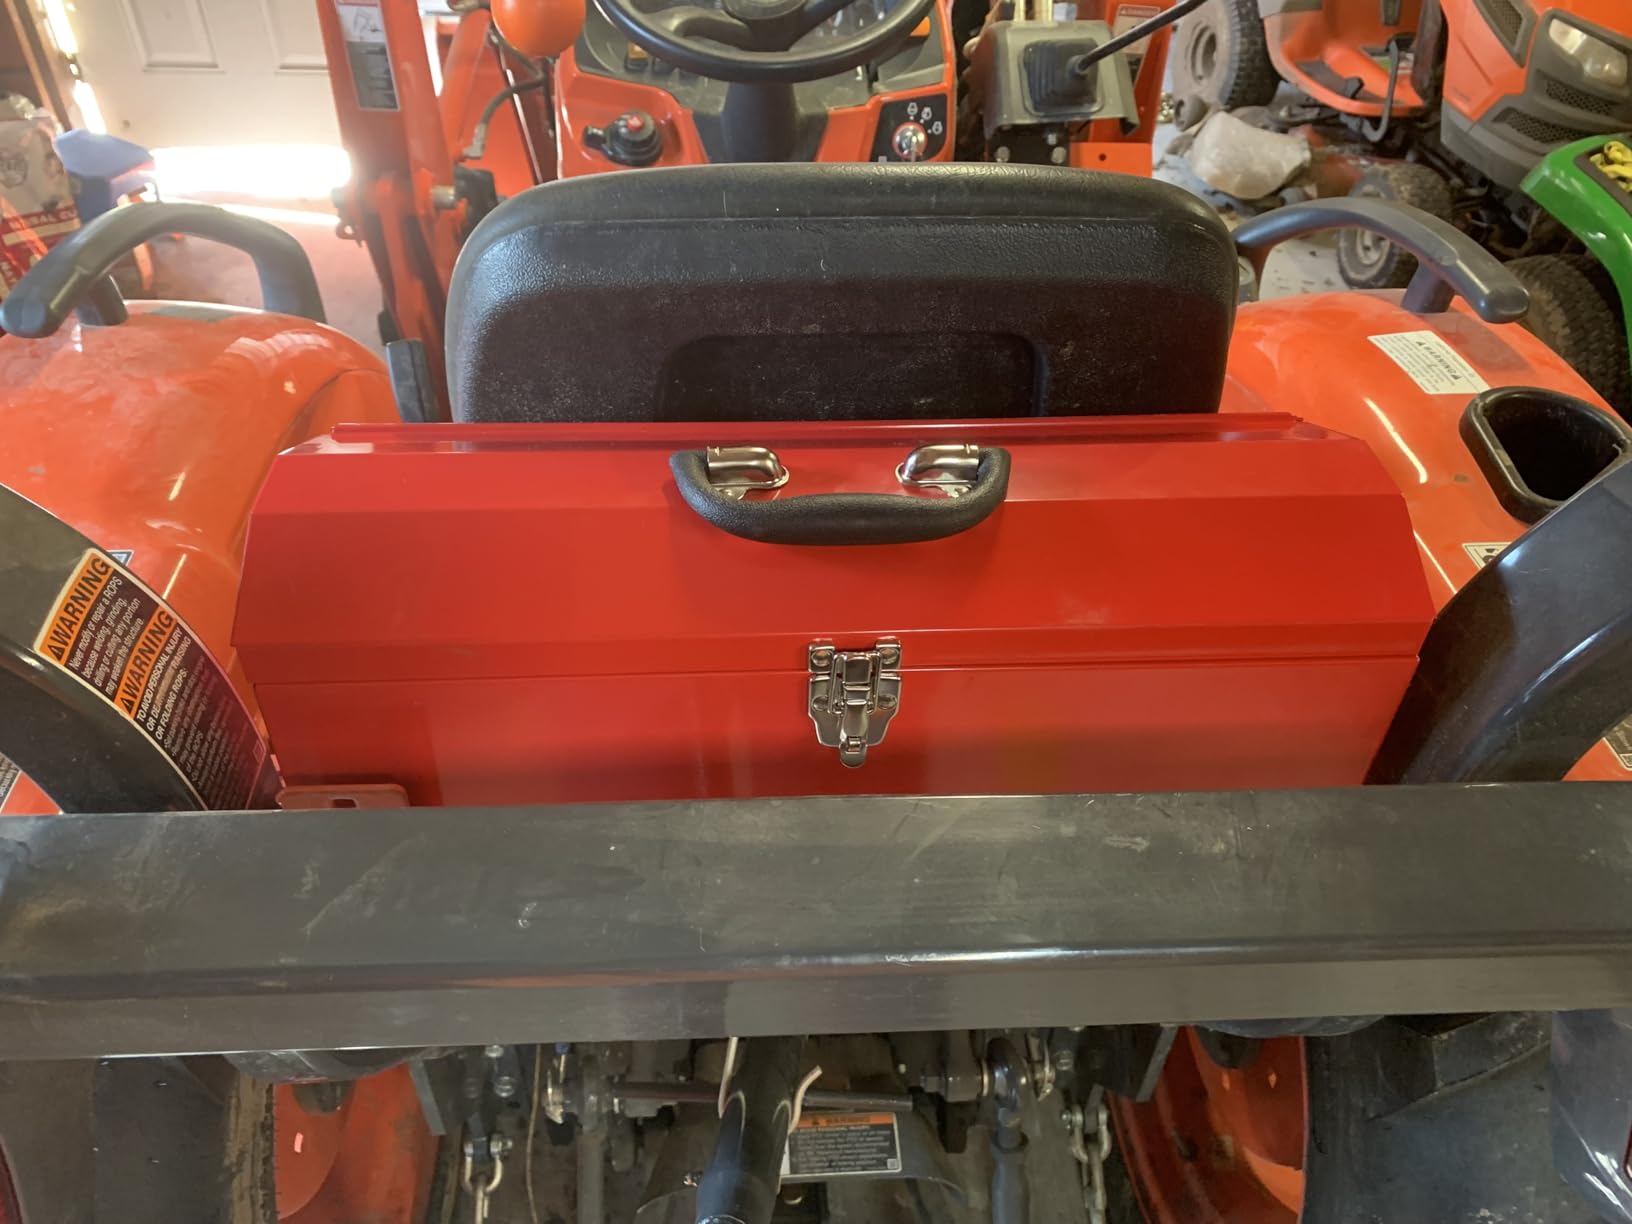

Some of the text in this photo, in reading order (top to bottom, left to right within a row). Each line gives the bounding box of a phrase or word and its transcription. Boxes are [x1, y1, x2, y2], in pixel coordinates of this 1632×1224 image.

[50, 556, 111, 647] WARNING
[103, 575, 123, 600] ROPS
[87, 621, 96, 631] or
[91, 601, 107, 624] repair
[79, 627, 94, 651] modify
[103, 655, 111, 666] or
[116, 620, 128, 636] any
[122, 597, 141, 624] portion
[164, 626, 183, 655] INJURY
[68, 649, 85, 670] Never
[81, 649, 99, 679] because
[122, 608, 175, 699] WARNING
[146, 716, 157, 732] OR
[170, 636, 191, 669] RAISING
[148, 651, 170, 692] PERSONAL
[140, 688, 155, 712] AVOID
[136, 709, 147, 722] TO
[155, 725, 165, 741] OR
[160, 691, 178, 728] FOLDING
